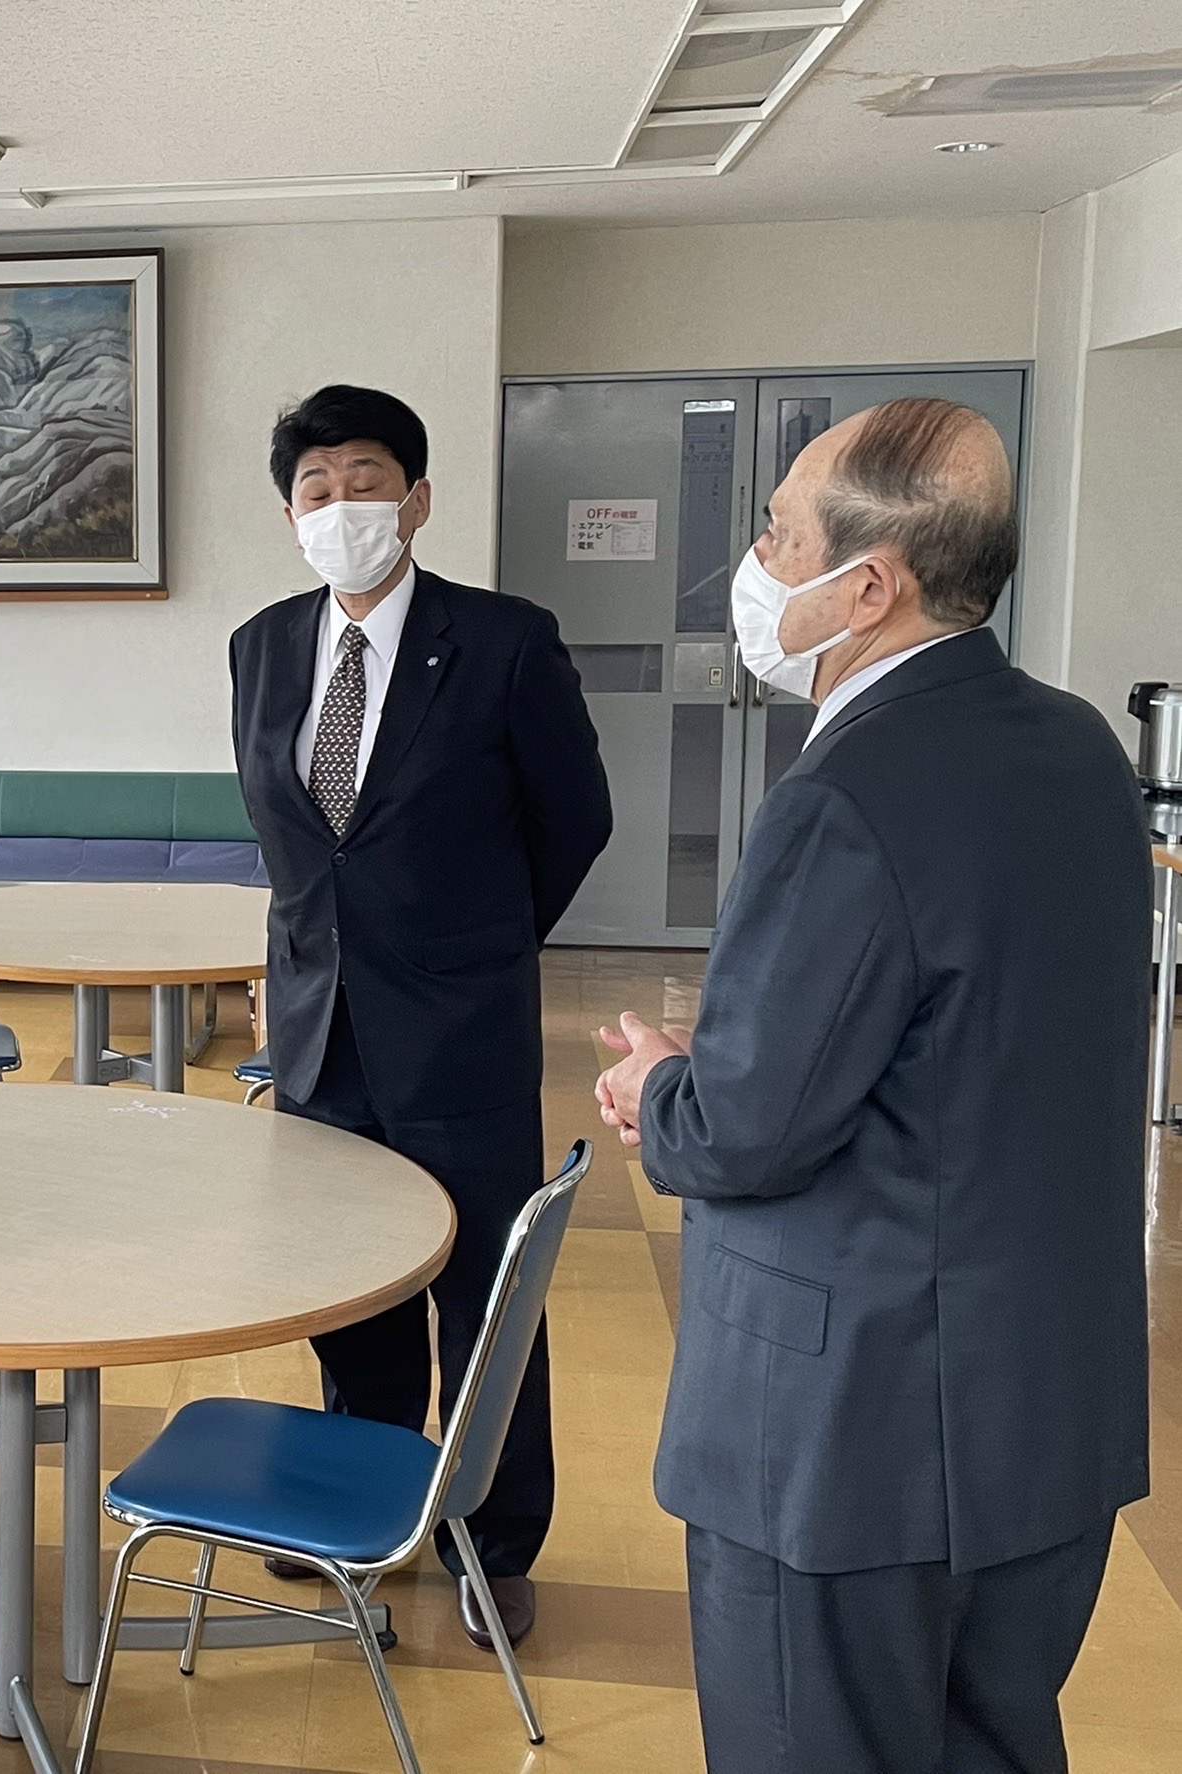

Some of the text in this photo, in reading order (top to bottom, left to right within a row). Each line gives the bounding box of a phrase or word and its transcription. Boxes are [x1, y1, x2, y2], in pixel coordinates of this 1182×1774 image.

[578, 522, 612, 530] エアコン
[578, 531, 603, 540] テレビ
